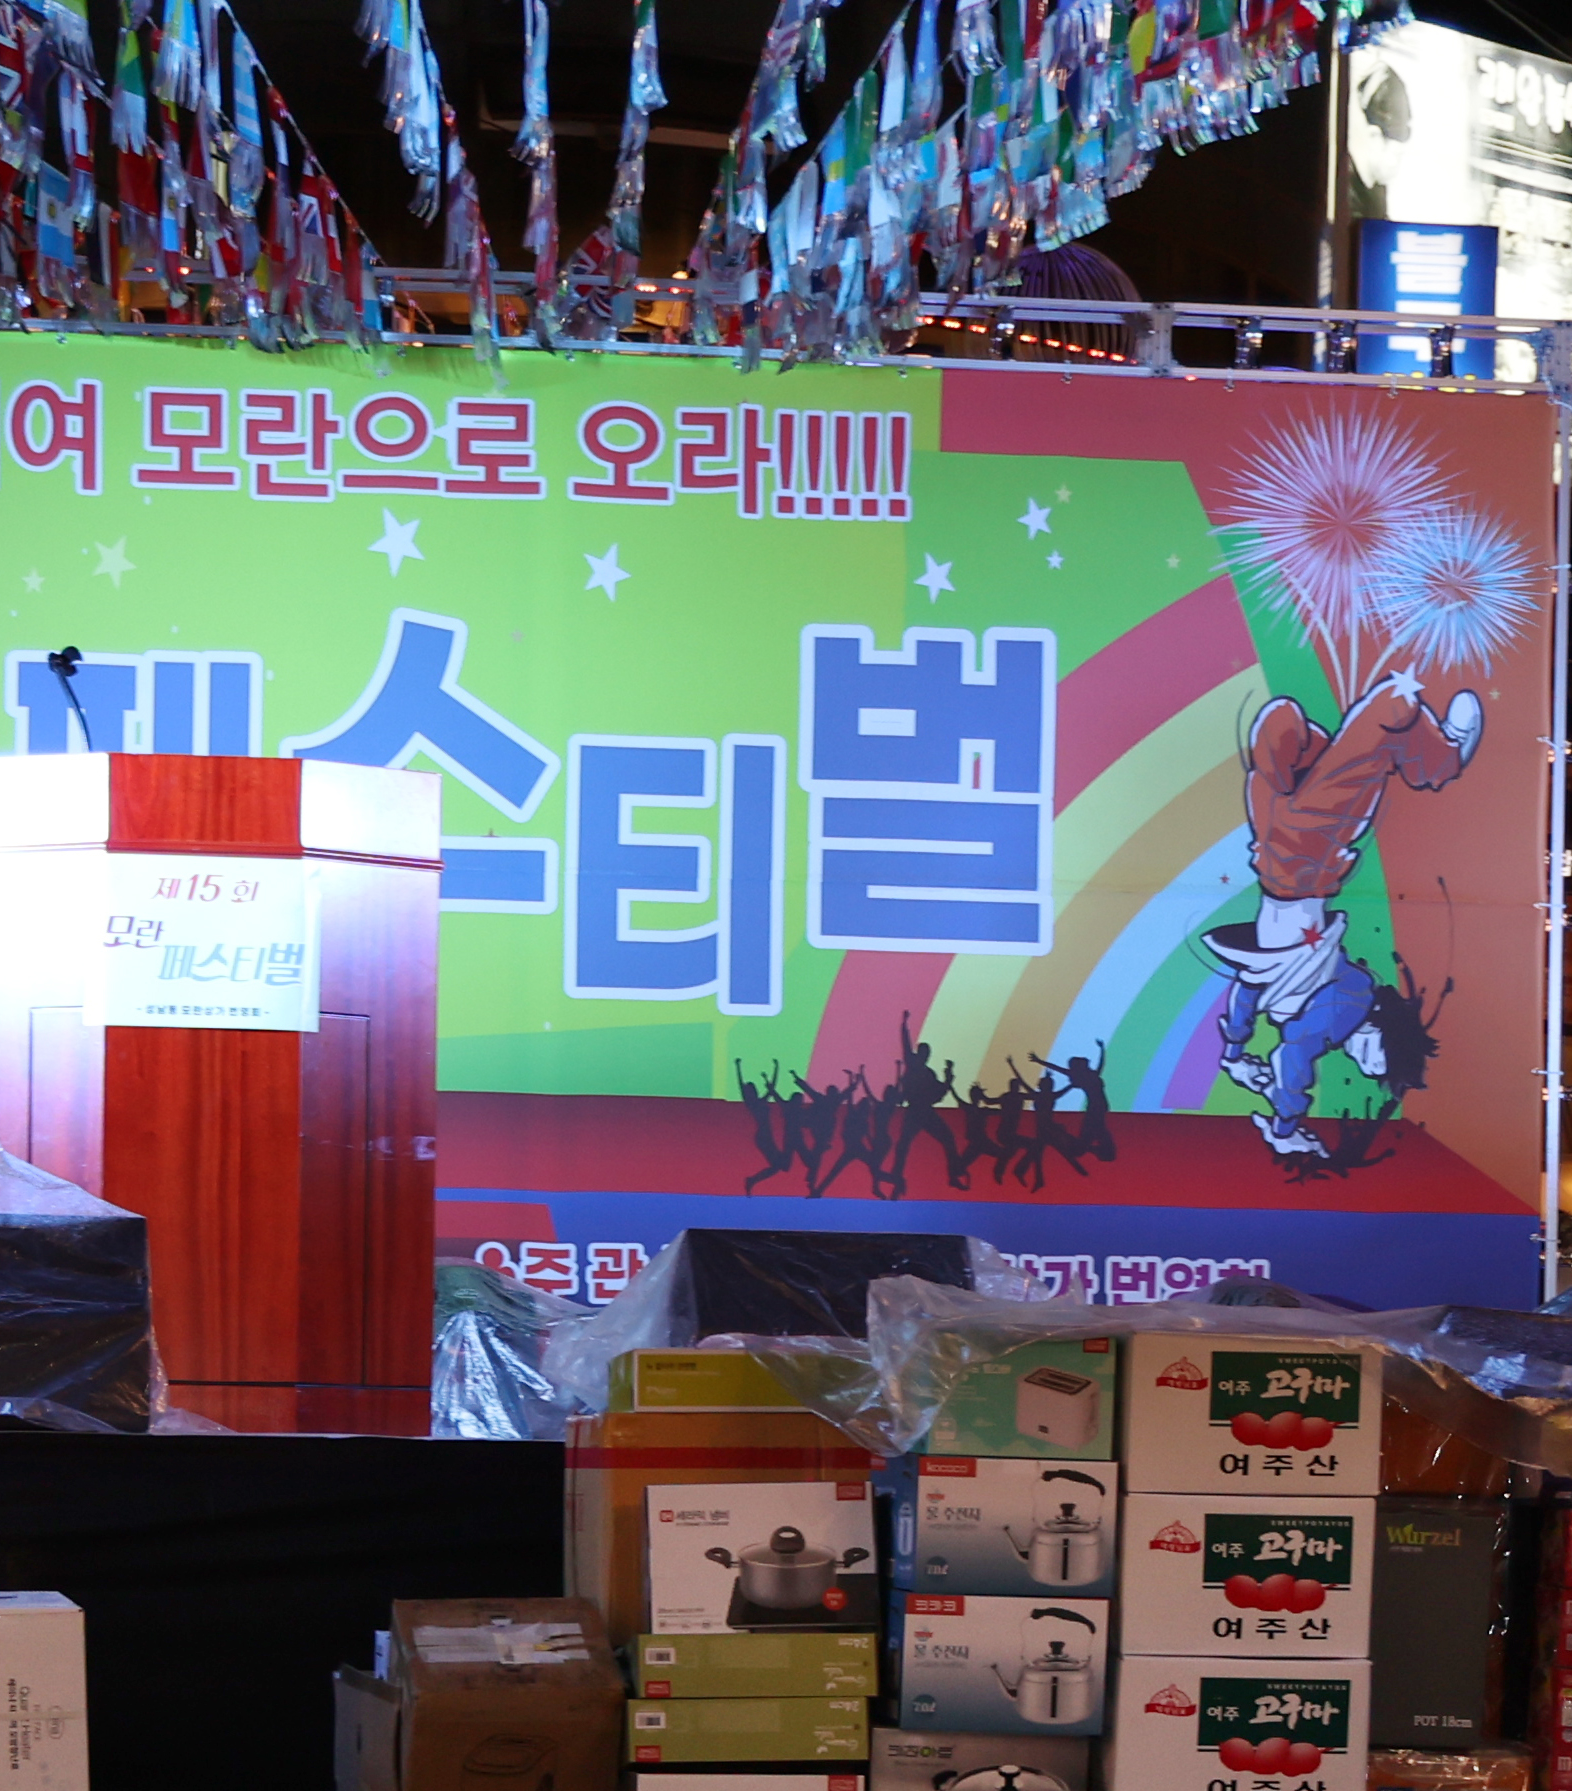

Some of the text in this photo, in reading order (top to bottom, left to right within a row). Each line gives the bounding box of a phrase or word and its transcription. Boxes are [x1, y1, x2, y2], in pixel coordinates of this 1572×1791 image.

[131, 388, 547, 502] 모란으로
[568, 401, 913, 521] 오라!!!!!
[103, 915, 165, 949] 모란
[158, 942, 305, 987] 페스티벌
[1218, 1380, 1251, 1396] 여주
[1260, 1367, 1351, 1404] 고구마
[1211, 1542, 1245, 1558] 여주
[1253, 1529, 1343, 1567] 고구마
[1386, 1524, 1462, 1547] Wurzel
[1206, 1705, 1240, 1722] 여주
[1248, 1693, 1340, 1731] 고구마
